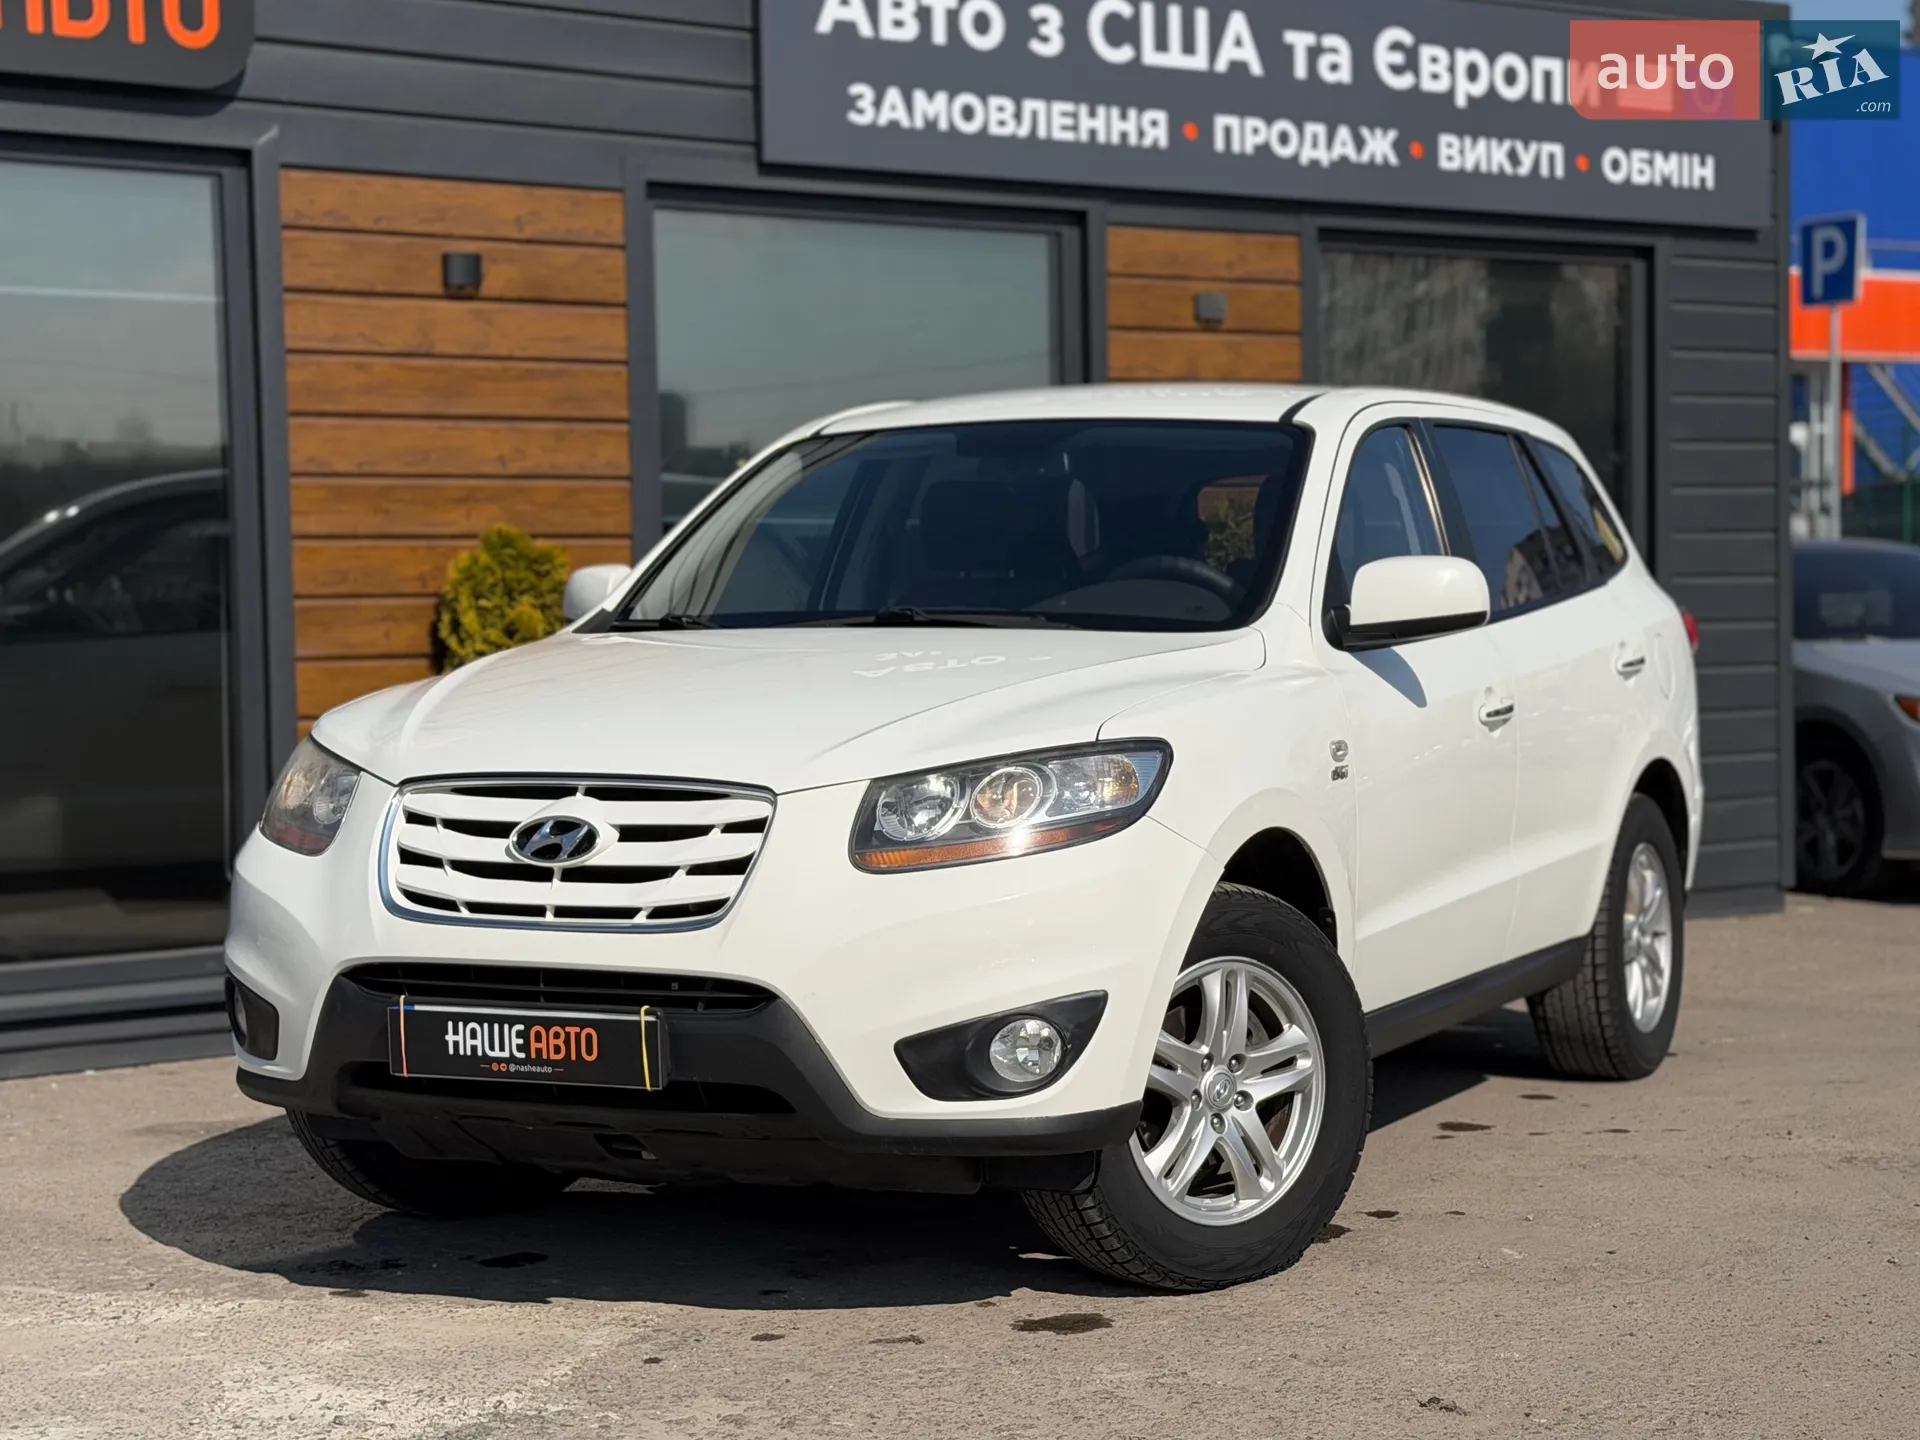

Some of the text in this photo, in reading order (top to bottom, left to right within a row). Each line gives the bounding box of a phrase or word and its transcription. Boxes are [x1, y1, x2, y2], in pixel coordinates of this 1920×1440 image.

[1027, 3, 1065, 57] з
[1087, 0, 1264, 77] США
[1283, 29, 1352, 84] та
[1373, 26, 1600, 108] Європи
[846, 82, 1716, 191] ЗАМОВЛЕННЯ ПРОДАЖ ВИКУП ОБМІН
[1811, 227, 1847, 298] P
[445, 1020, 599, 1062] НАШЕ АВТО
